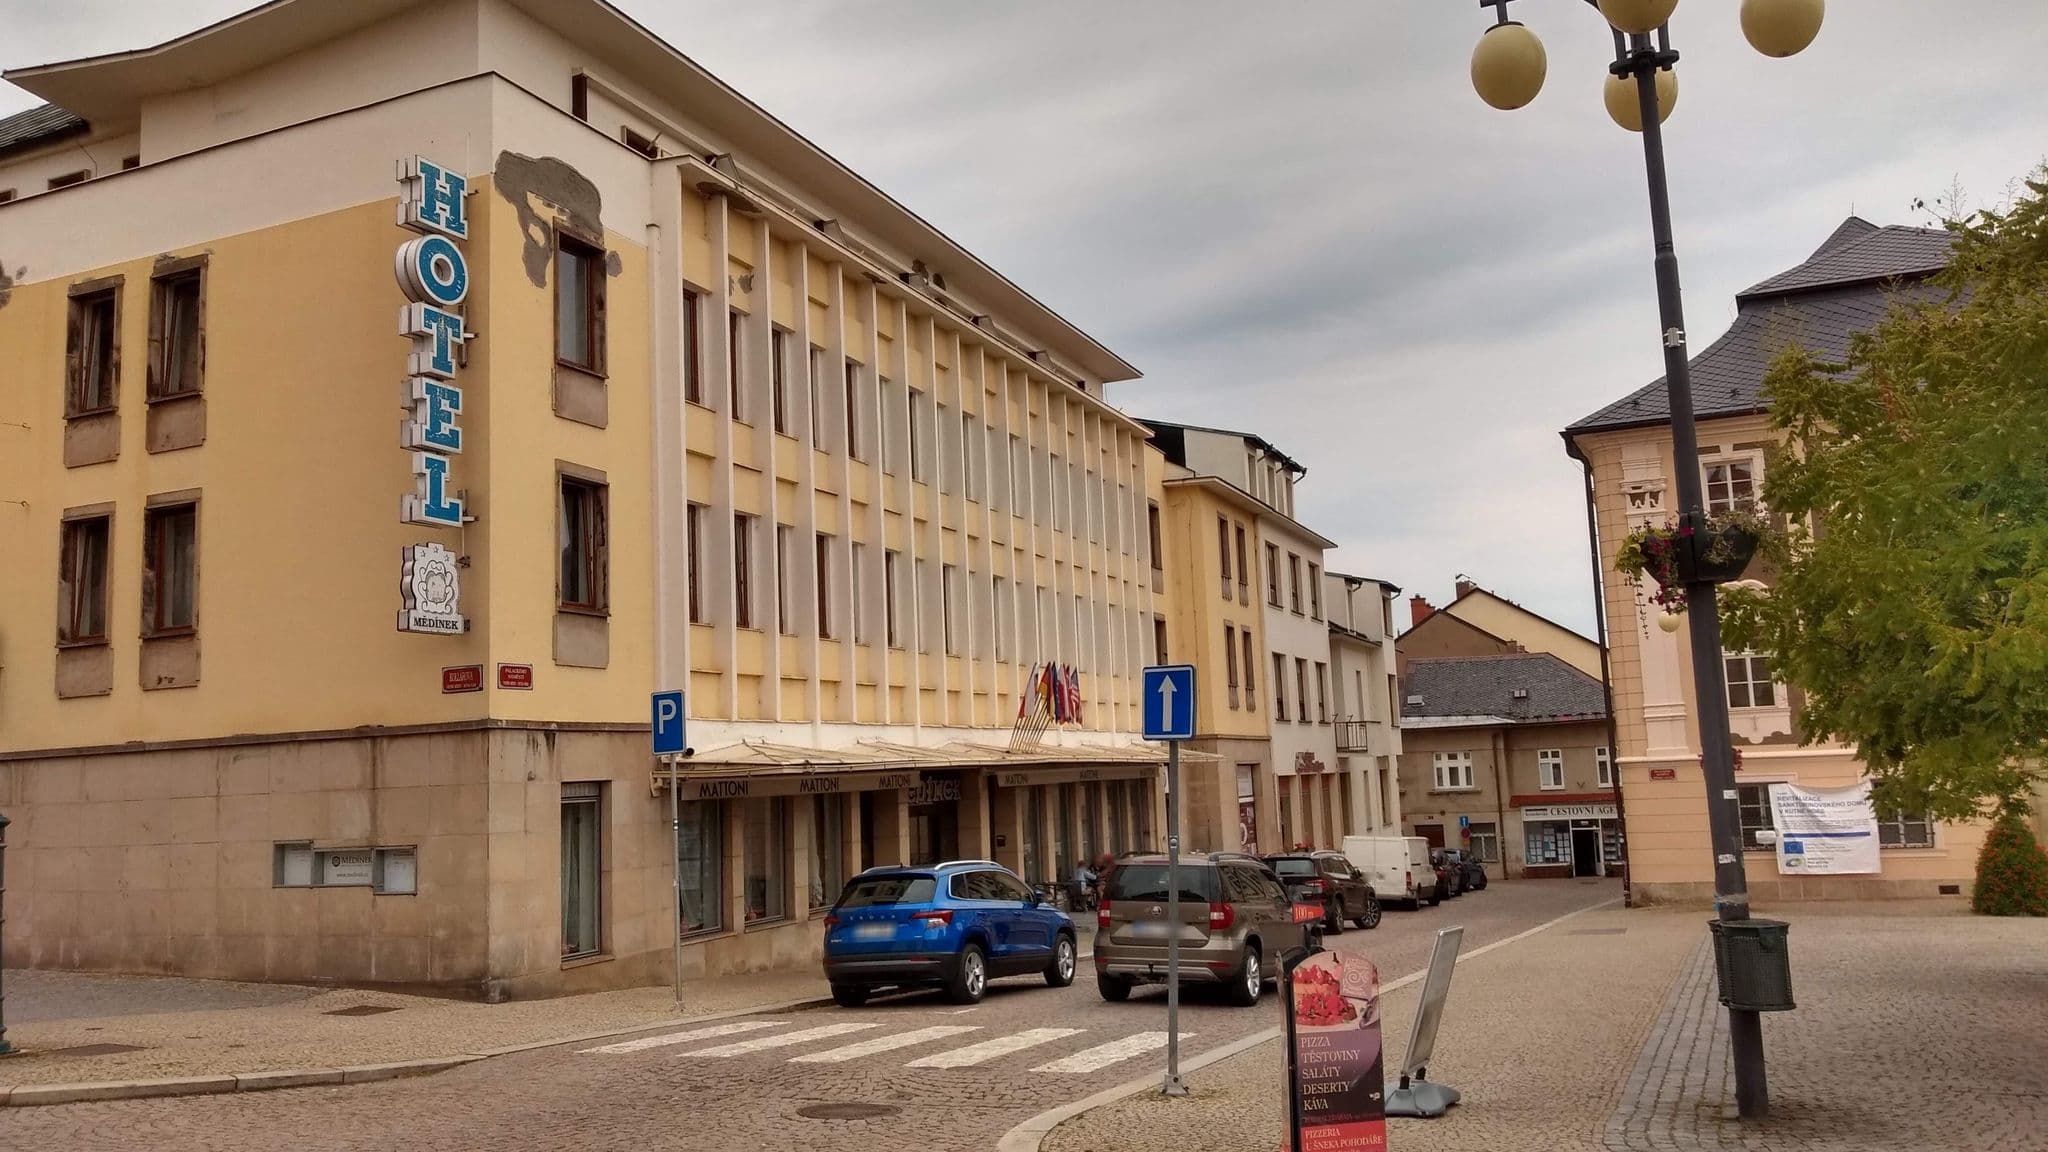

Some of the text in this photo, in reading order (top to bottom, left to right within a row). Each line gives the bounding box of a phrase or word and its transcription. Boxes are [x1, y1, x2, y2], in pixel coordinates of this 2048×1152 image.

[412, 155, 469, 528] HOTEL
[413, 615, 459, 631] MĚDÍNEK
[658, 699, 677, 735] P
[800, 777, 840, 793] MATTONI
[879, 774, 911, 788] MATTONI
[700, 780, 749, 798] MATTONI
[1550, 806, 1594, 816] CESTOVNÍ
[1295, 906, 1314, 920] 100 m
[1301, 1036, 1331, 1048] PIZZA
[1301, 1049, 1360, 1063] TĚSTOVINY
[1302, 1066, 1341, 1080] SALÁTY
[1303, 1081, 1350, 1095] DESERTY
[1303, 1097, 1329, 1111] KÁVA
[1305, 1128, 1341, 1139] PIZZERIA
[1313, 1139, 1339, 1150] ŠNEKA
[1340, 1135, 1384, 1148] POHODÁŘE
